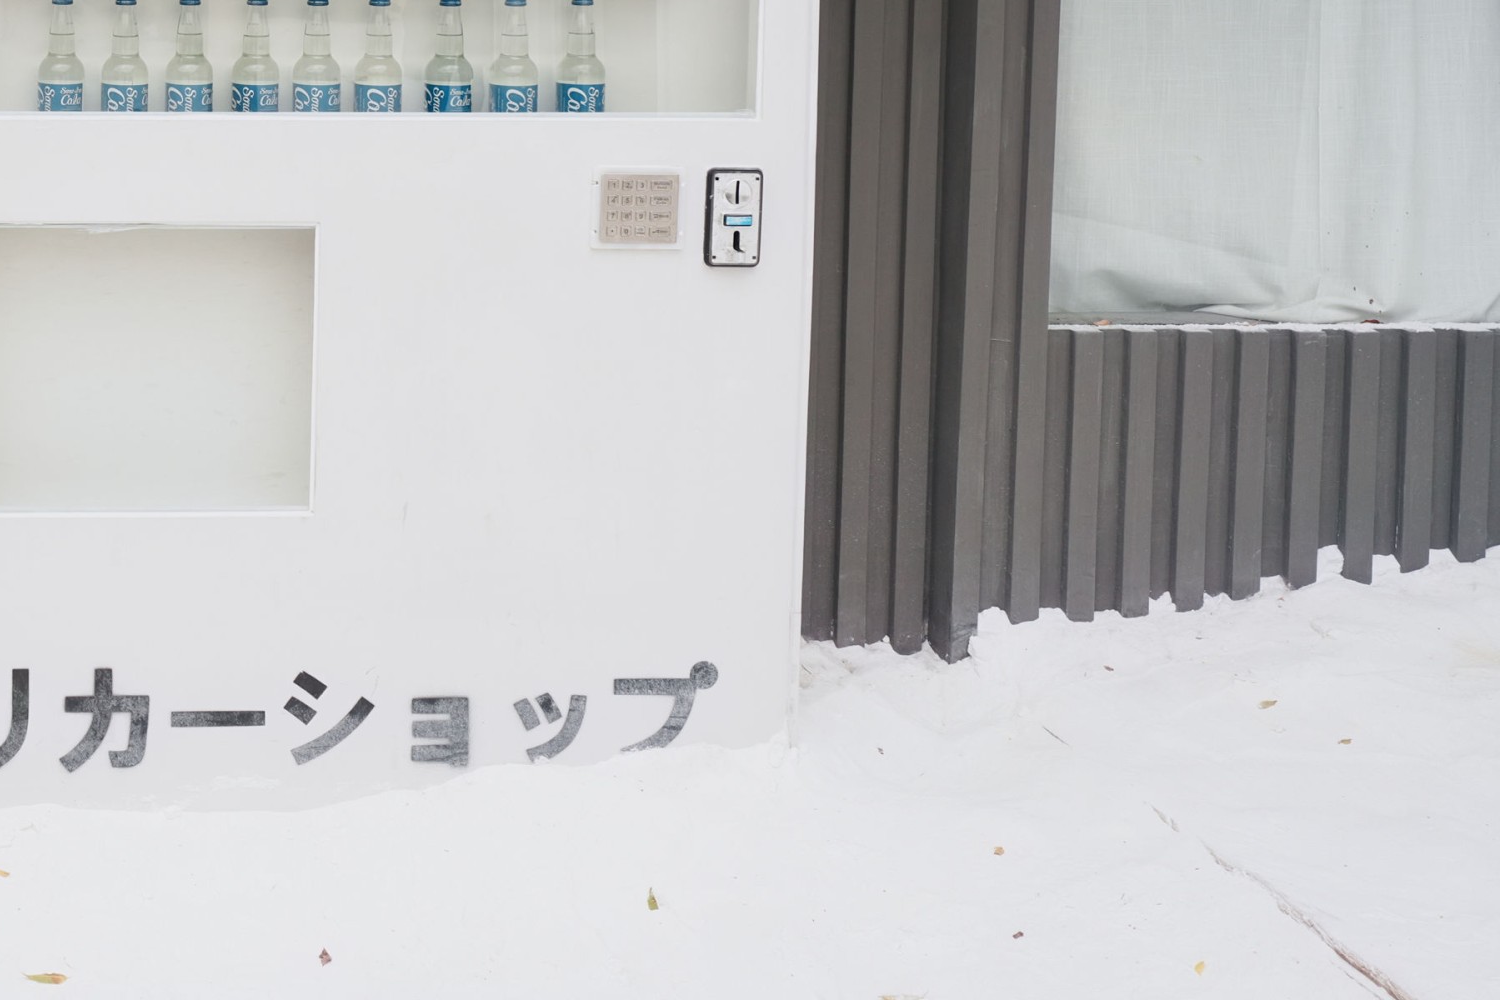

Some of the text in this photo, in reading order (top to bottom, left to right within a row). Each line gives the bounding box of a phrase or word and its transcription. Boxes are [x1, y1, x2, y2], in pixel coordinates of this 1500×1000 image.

[107, 87, 126, 112] Co
[366, 88, 388, 112] Co
[506, 88, 527, 112] Co
[567, 87, 588, 112] Co
